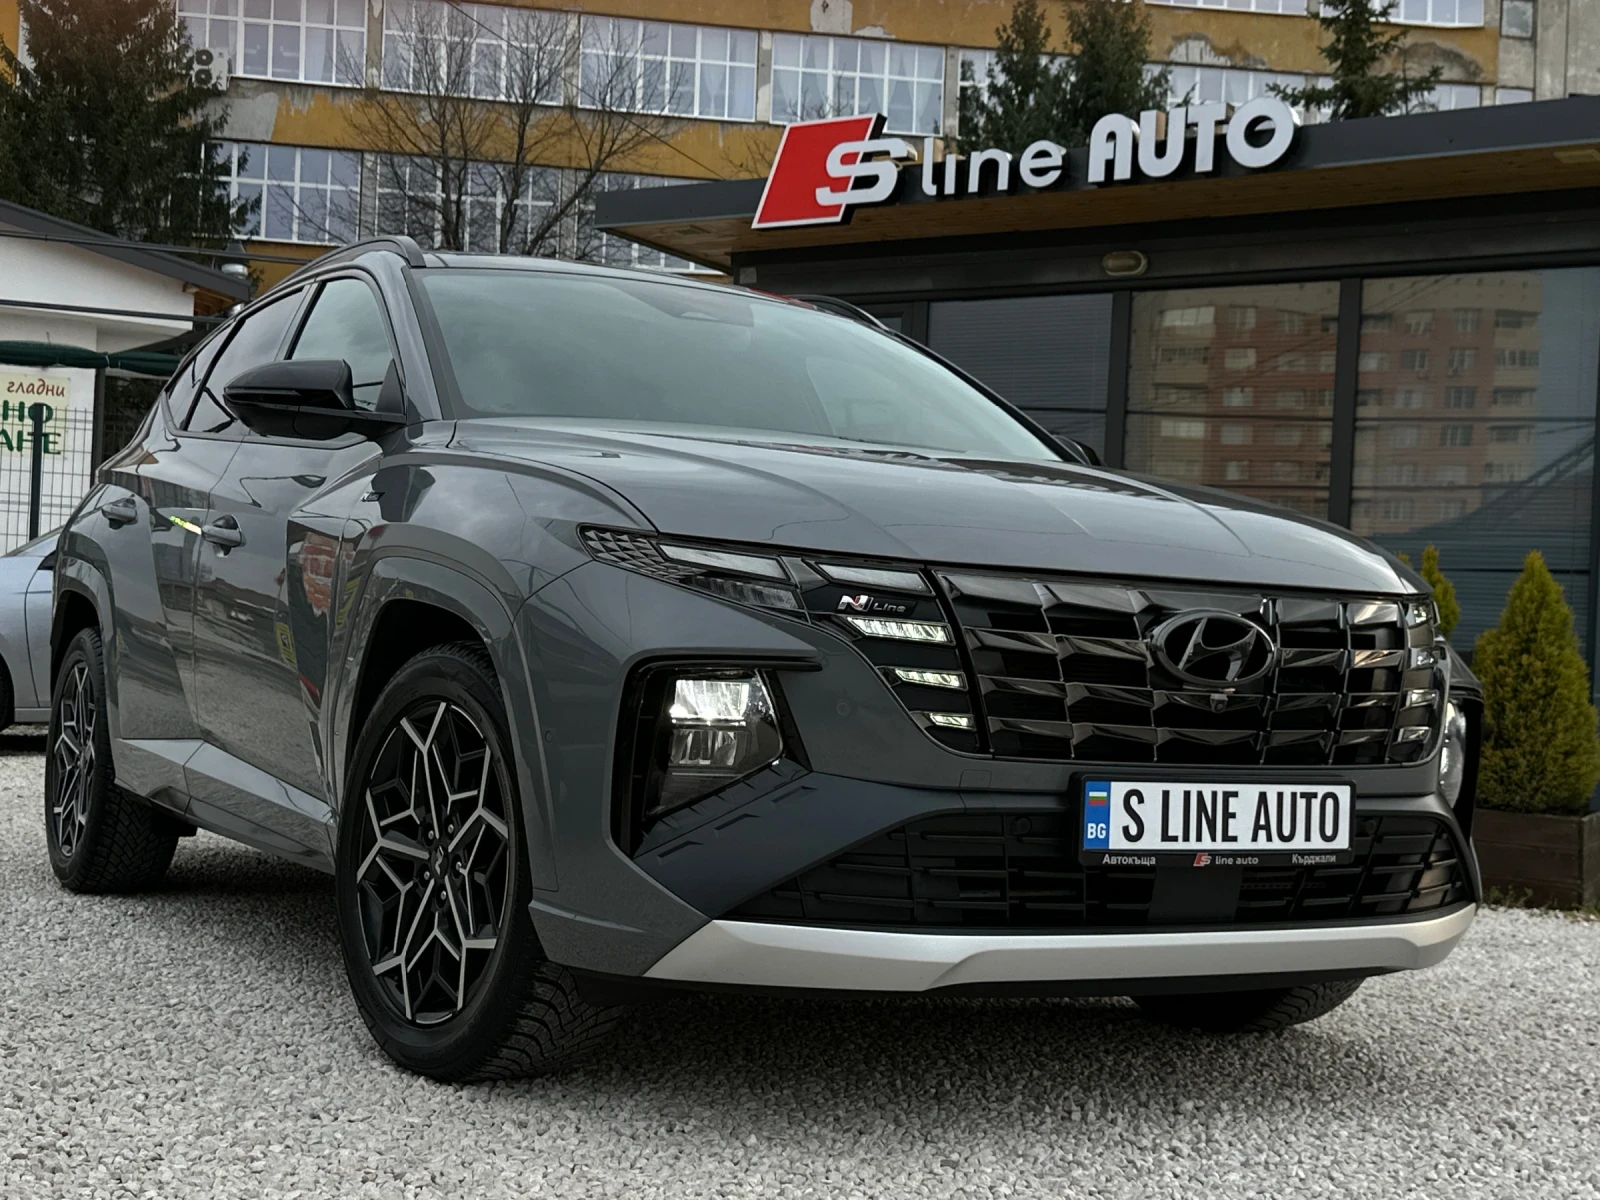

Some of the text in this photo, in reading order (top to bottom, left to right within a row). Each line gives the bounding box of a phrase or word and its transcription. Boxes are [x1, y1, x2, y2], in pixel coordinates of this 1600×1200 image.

[815, 99, 1298, 206] S line AUTO
[6, 378, 66, 398] гладни
[1121, 788, 1341, 843] S LINE AUTO
[1087, 823, 1107, 840] BG
[1102, 854, 1156, 866] Автокъща
[1215, 855, 1234, 865] line
[1235, 856, 1259, 865] auto
[1291, 853, 1337, 864] Кърджали
